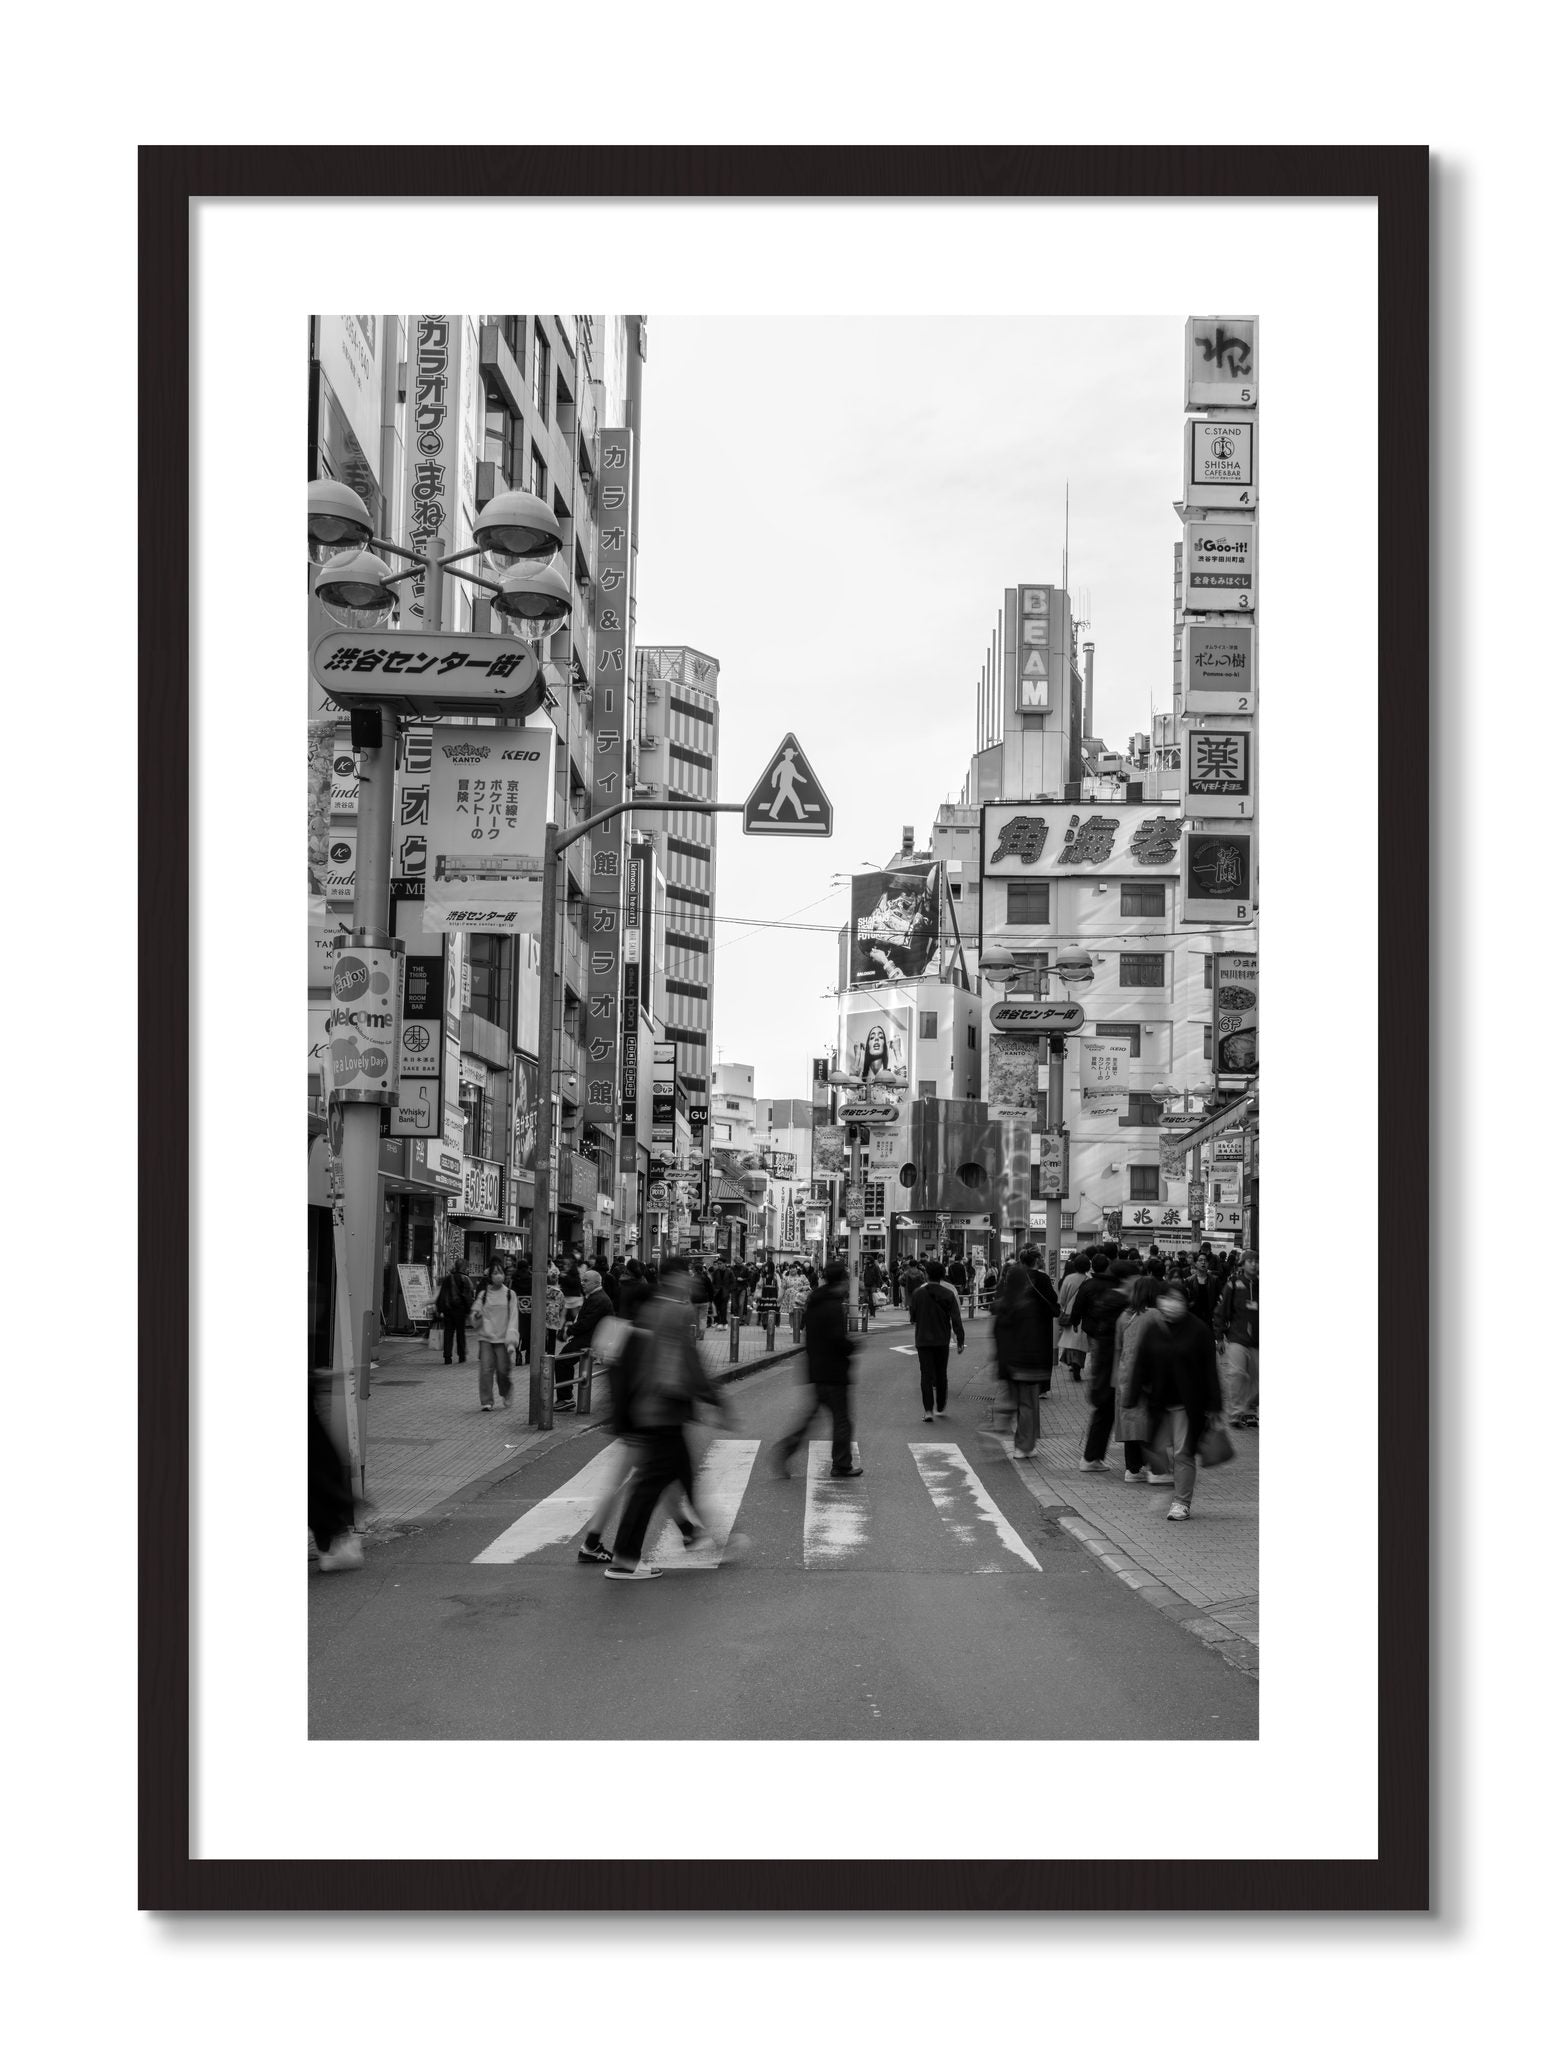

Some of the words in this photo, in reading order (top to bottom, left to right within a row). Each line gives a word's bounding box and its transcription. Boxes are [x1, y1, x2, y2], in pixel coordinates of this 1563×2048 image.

[415, 316, 449, 432] カラオケ
[1241, 389, 1250, 402] 5
[1204, 427, 1241, 436] C.STAND
[1204, 460, 1241, 470] SHISHA
[1239, 491, 1249, 504] 4
[1203, 539, 1248, 553] Goo-it!
[1193, 575, 1249, 586] 全身もみほぐし
[1239, 594, 1249, 608] 3
[1022, 588, 1049, 706] BEAM
[324, 647, 526, 678] 渋谷センター街
[1238, 697, 1248, 711] 2
[501, 750, 541, 762] KEIO
[1197, 736, 1238, 778] 薬
[456, 779, 470, 814] 冒険へ
[334, 800, 354, 809] 渋谷店
[471, 779, 485, 839] カントーの
[487, 779, 502, 839] ポケパーク
[505, 780, 519, 829] 京王線で
[1238, 802, 1245, 814] 1
[990, 815, 1184, 865] 角海老
[630, 863, 638, 892] kimono
[331, 888, 351, 896] 渋谷店
[445, 910, 518, 922] 渋谷センター街
[1237, 905, 1247, 919] B
[334, 966, 367, 995] Enjoy
[588, 909, 617, 1107] カラオケ館
[995, 1008, 1079, 1020] 渋谷センター街
[330, 1008, 393, 1028] Welcome
[1219, 1016, 1242, 1033] 6F
[344, 1055, 369, 1071] Lovely
[370, 1055, 387, 1067] Day!
[398, 1115, 415, 1123] Bank
[399, 1108, 427, 1117] Whisky
[690, 1111, 707, 1120] GU
[840, 1108, 892, 1116] 渋谷センター街
